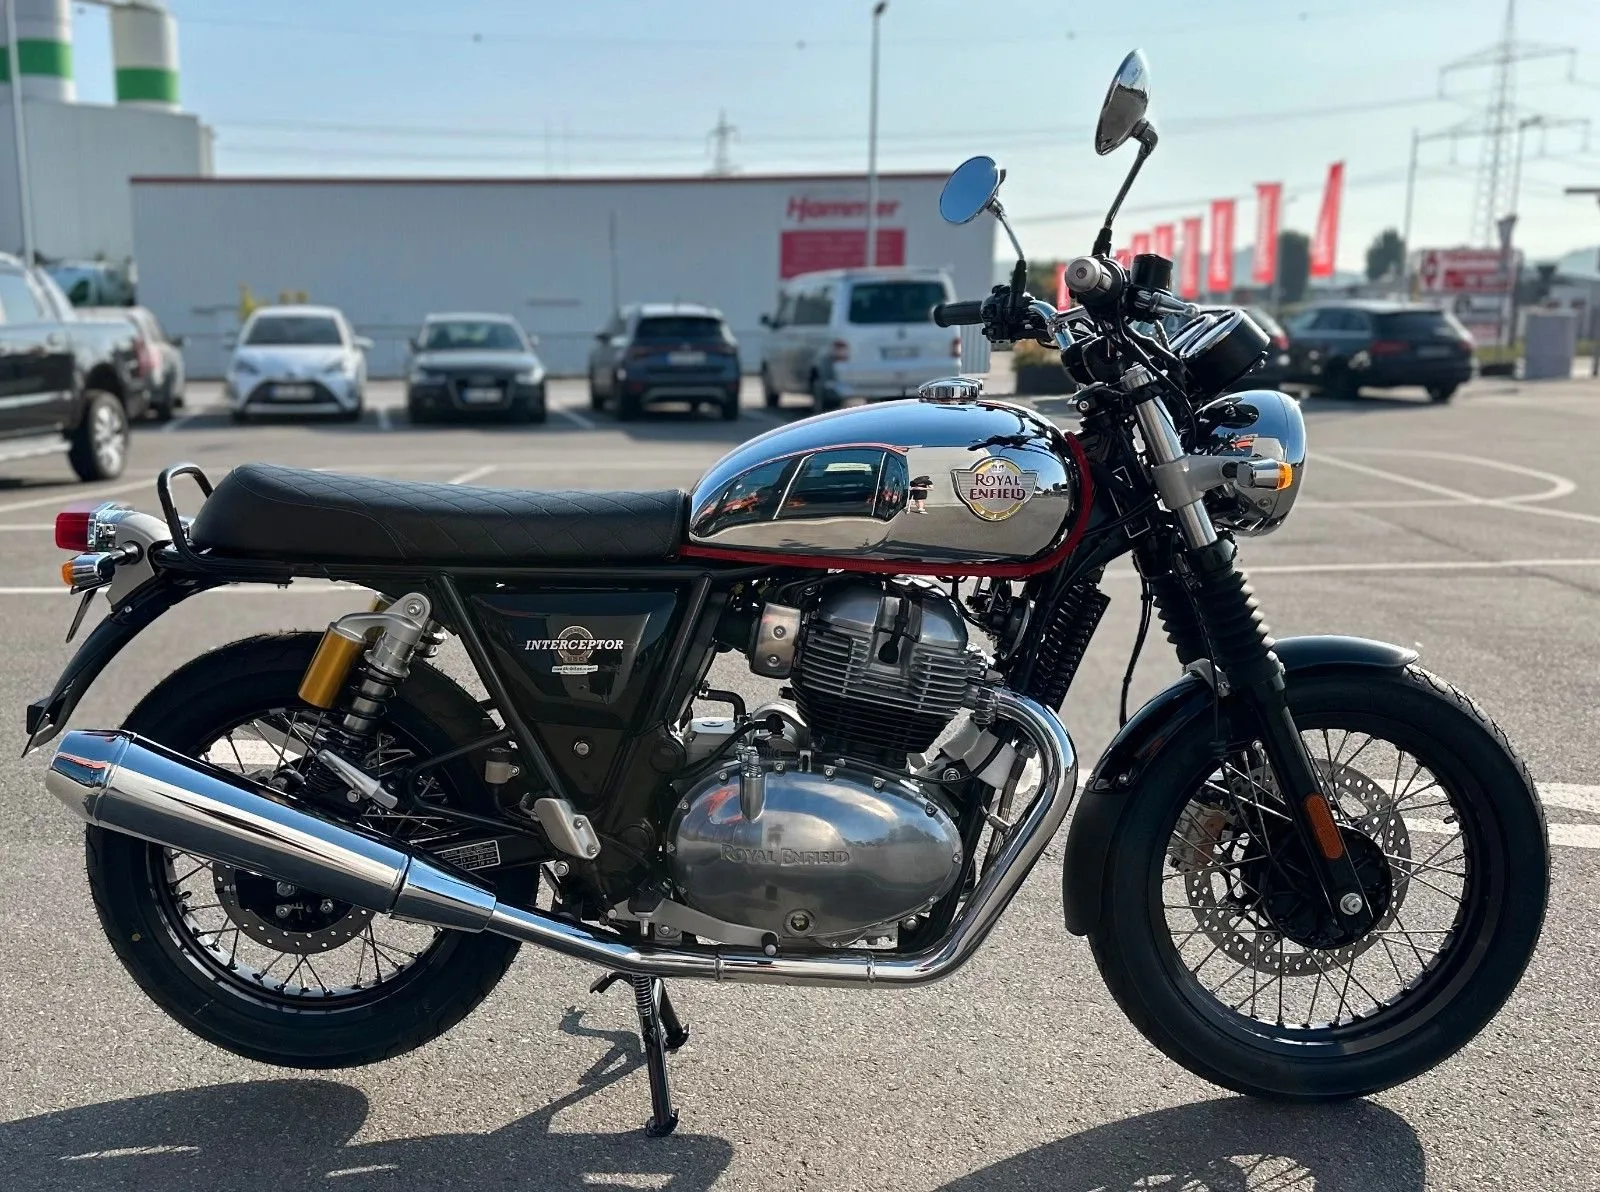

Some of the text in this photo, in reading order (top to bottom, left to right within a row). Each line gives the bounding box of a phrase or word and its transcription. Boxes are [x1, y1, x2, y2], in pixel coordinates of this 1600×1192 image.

[975, 473, 1021, 487] ROYAL
[969, 488, 1026, 500] ENFIELD
[524, 639, 624, 651] INTERCEPTOR
[720, 843, 850, 867] ROYAL ENFIELD
